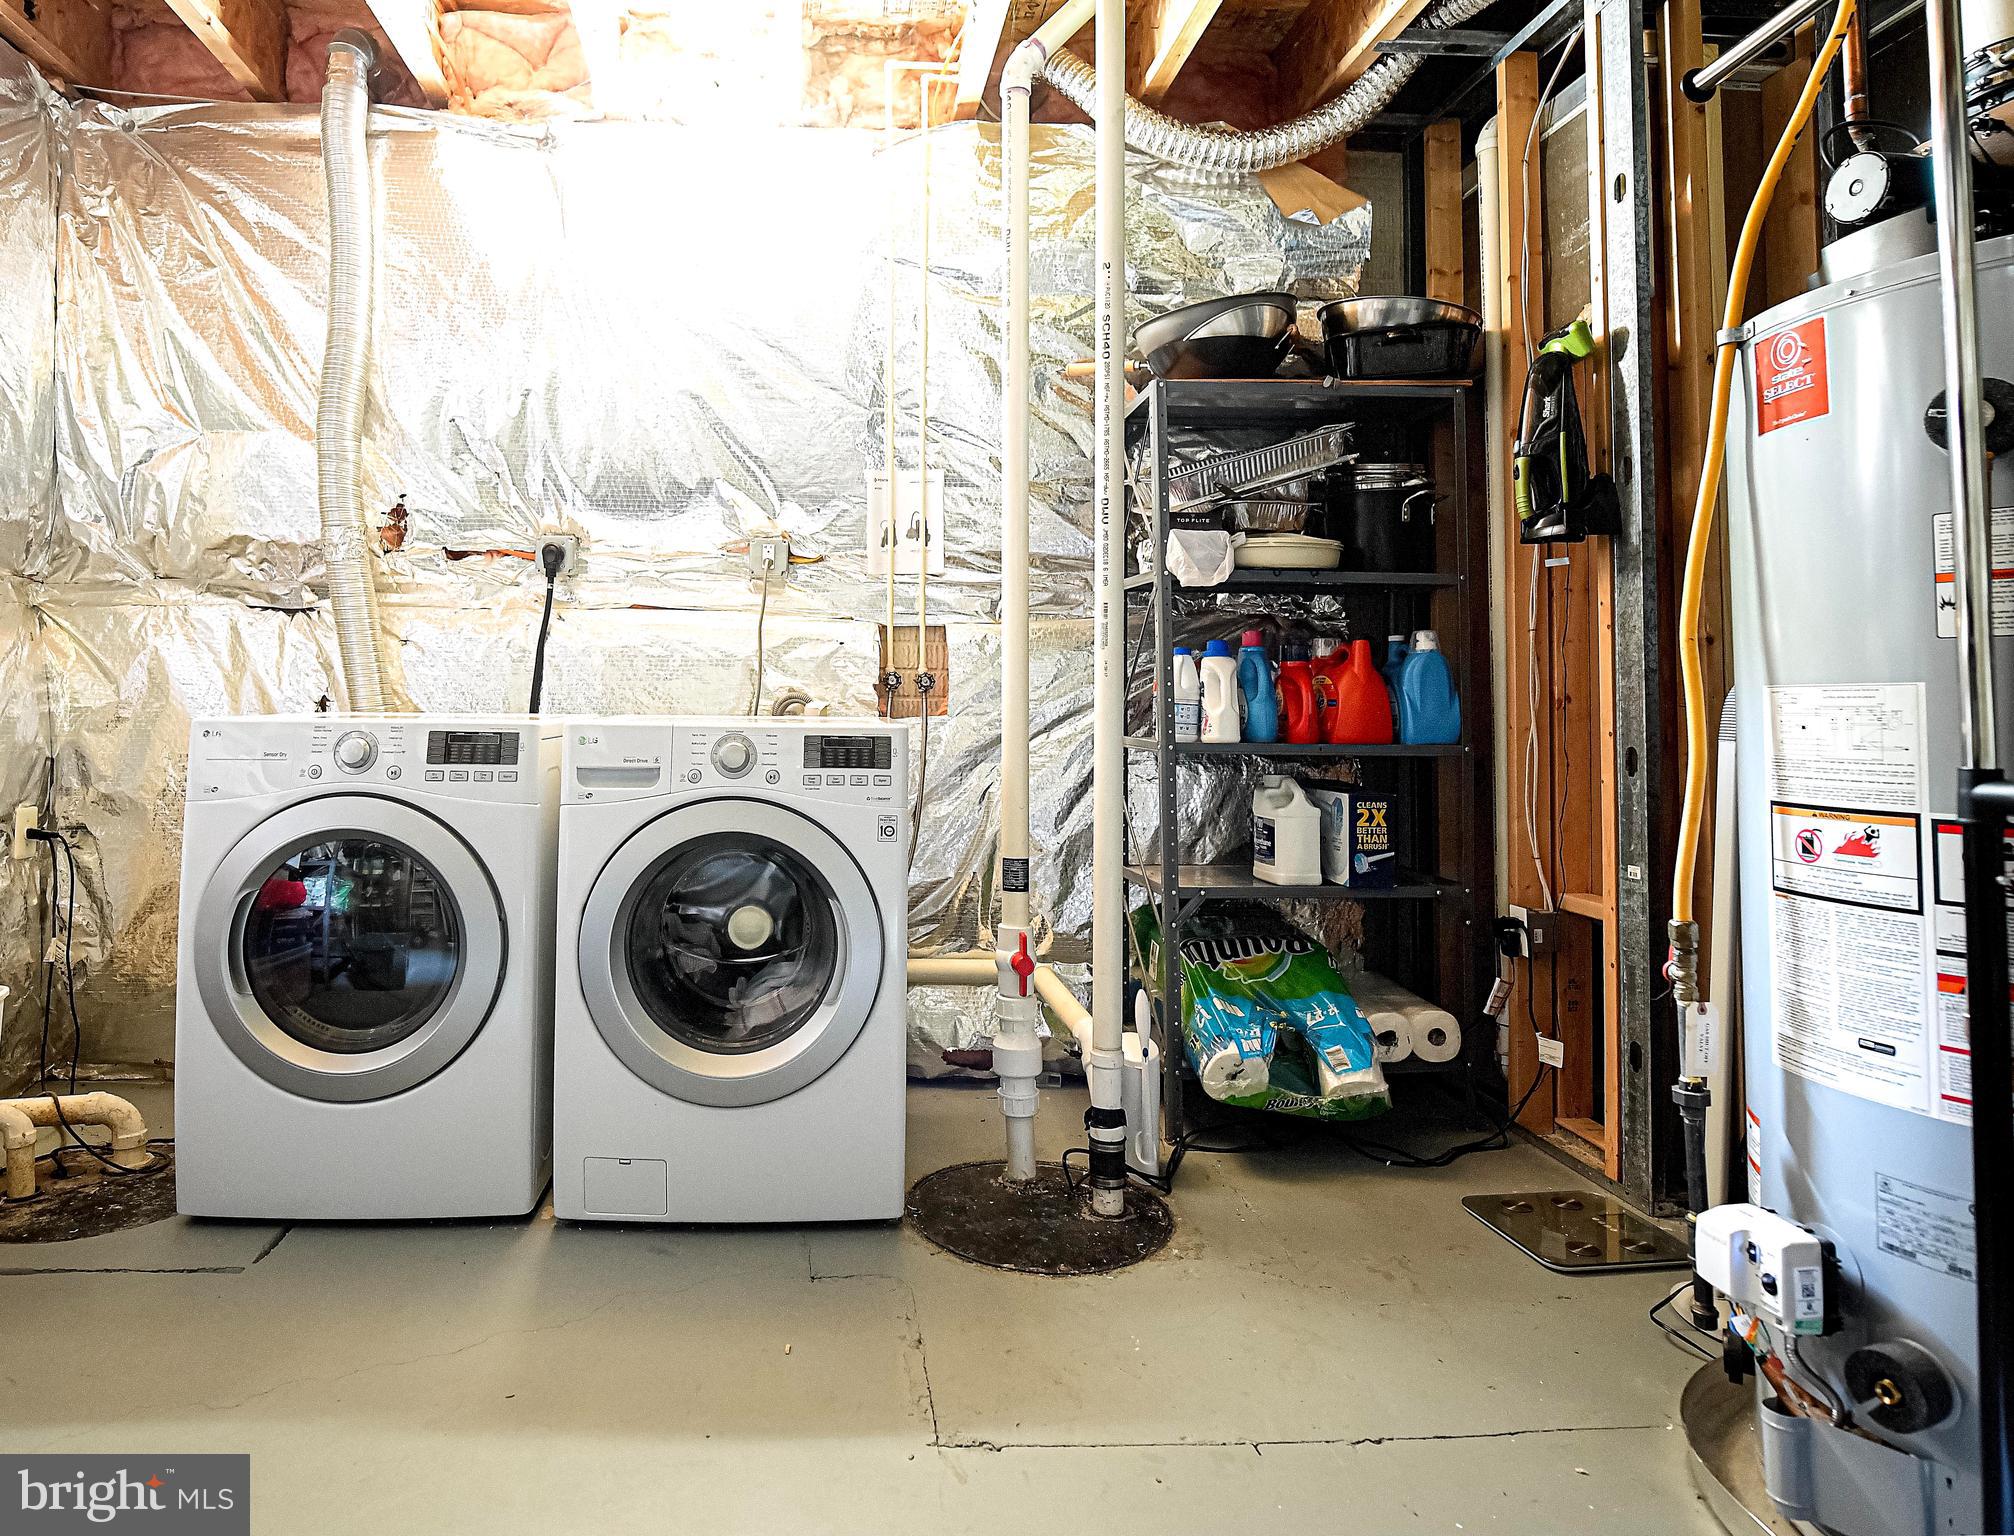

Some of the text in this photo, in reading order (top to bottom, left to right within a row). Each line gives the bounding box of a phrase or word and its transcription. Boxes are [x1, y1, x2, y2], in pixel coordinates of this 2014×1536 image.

[1102, 314, 1111, 360] SCH40
[1763, 374, 1815, 400] SELECT
[1542, 396, 1551, 418] Shark
[1101, 497, 1109, 525] DWV
[1356, 801, 1388, 809] CLEANS
[1356, 809, 1387, 827] 2X
[1818, 812, 1851, 821] WARNING
[880, 825, 895, 837] 10
[1356, 834, 1388, 844] THAN
